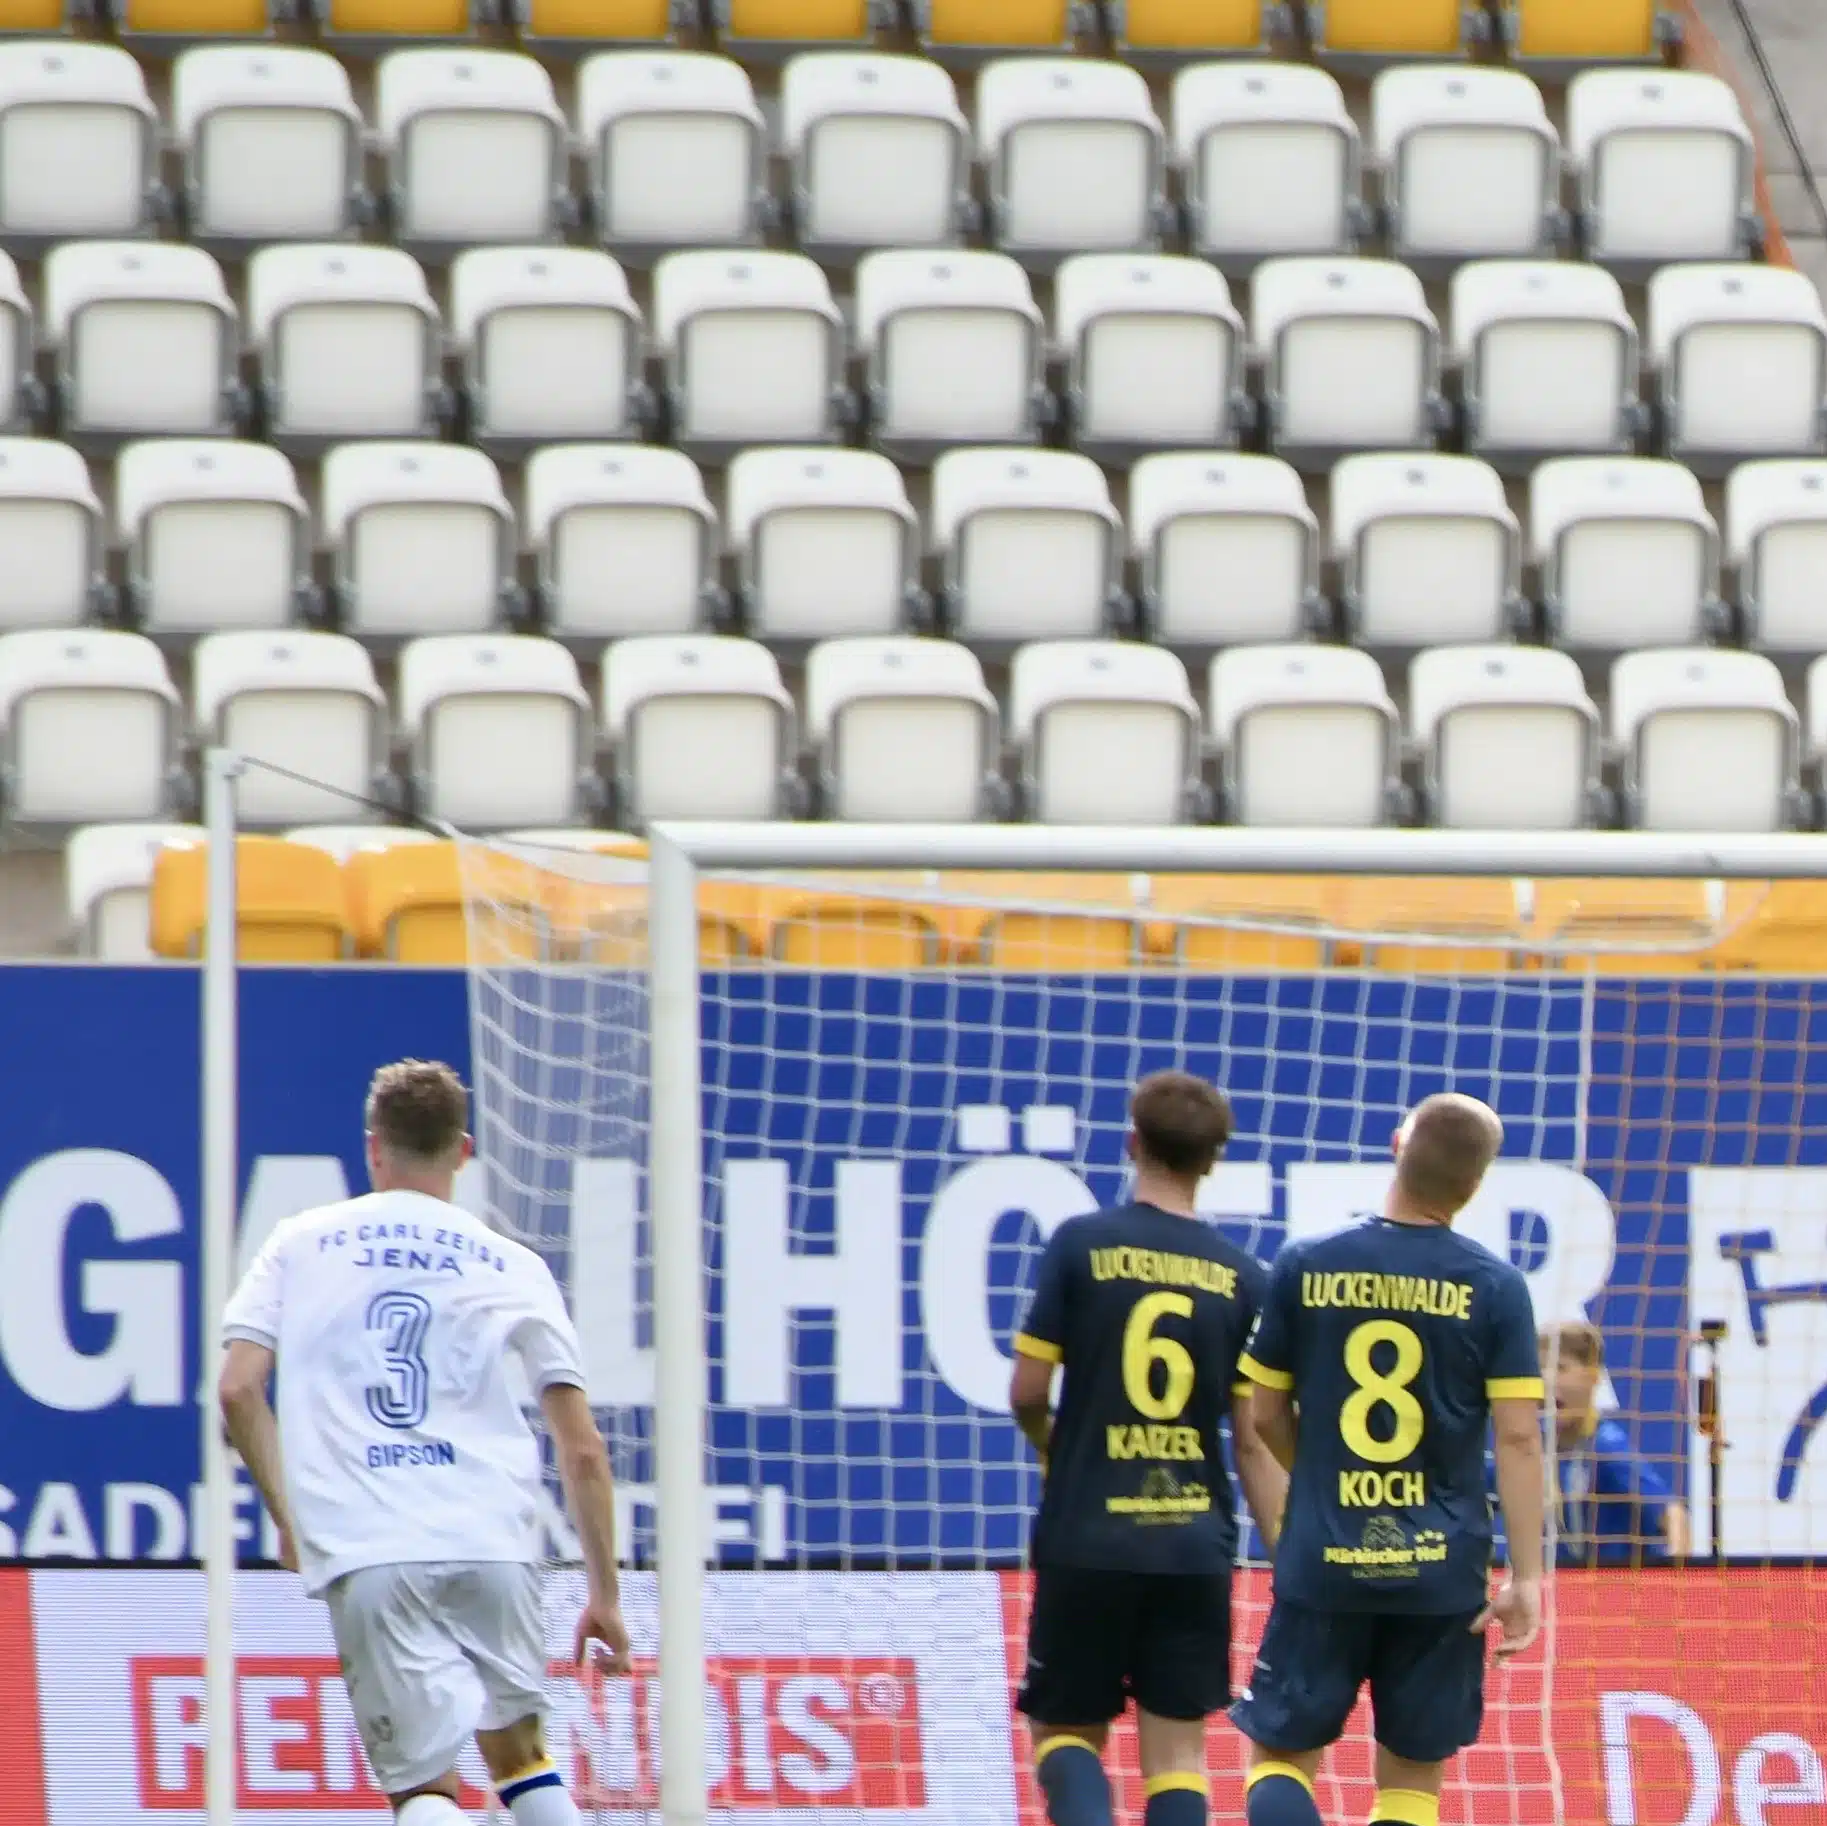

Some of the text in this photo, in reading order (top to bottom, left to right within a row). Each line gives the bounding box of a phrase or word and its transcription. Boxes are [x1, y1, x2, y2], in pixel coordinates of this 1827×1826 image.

[318, 1229, 347, 1253] FC
[356, 1223, 423, 1243] CARL
[352, 1247, 464, 1278] JENA
[1302, 1271, 1474, 1320] LUCKENWALDE
[365, 1291, 431, 1429] 3
[1121, 1290, 1195, 1421] 6
[1340, 1318, 1425, 1464] 8
[366, 1441, 456, 1469] GIPSON
[1338, 1470, 1425, 1508] KOCH
